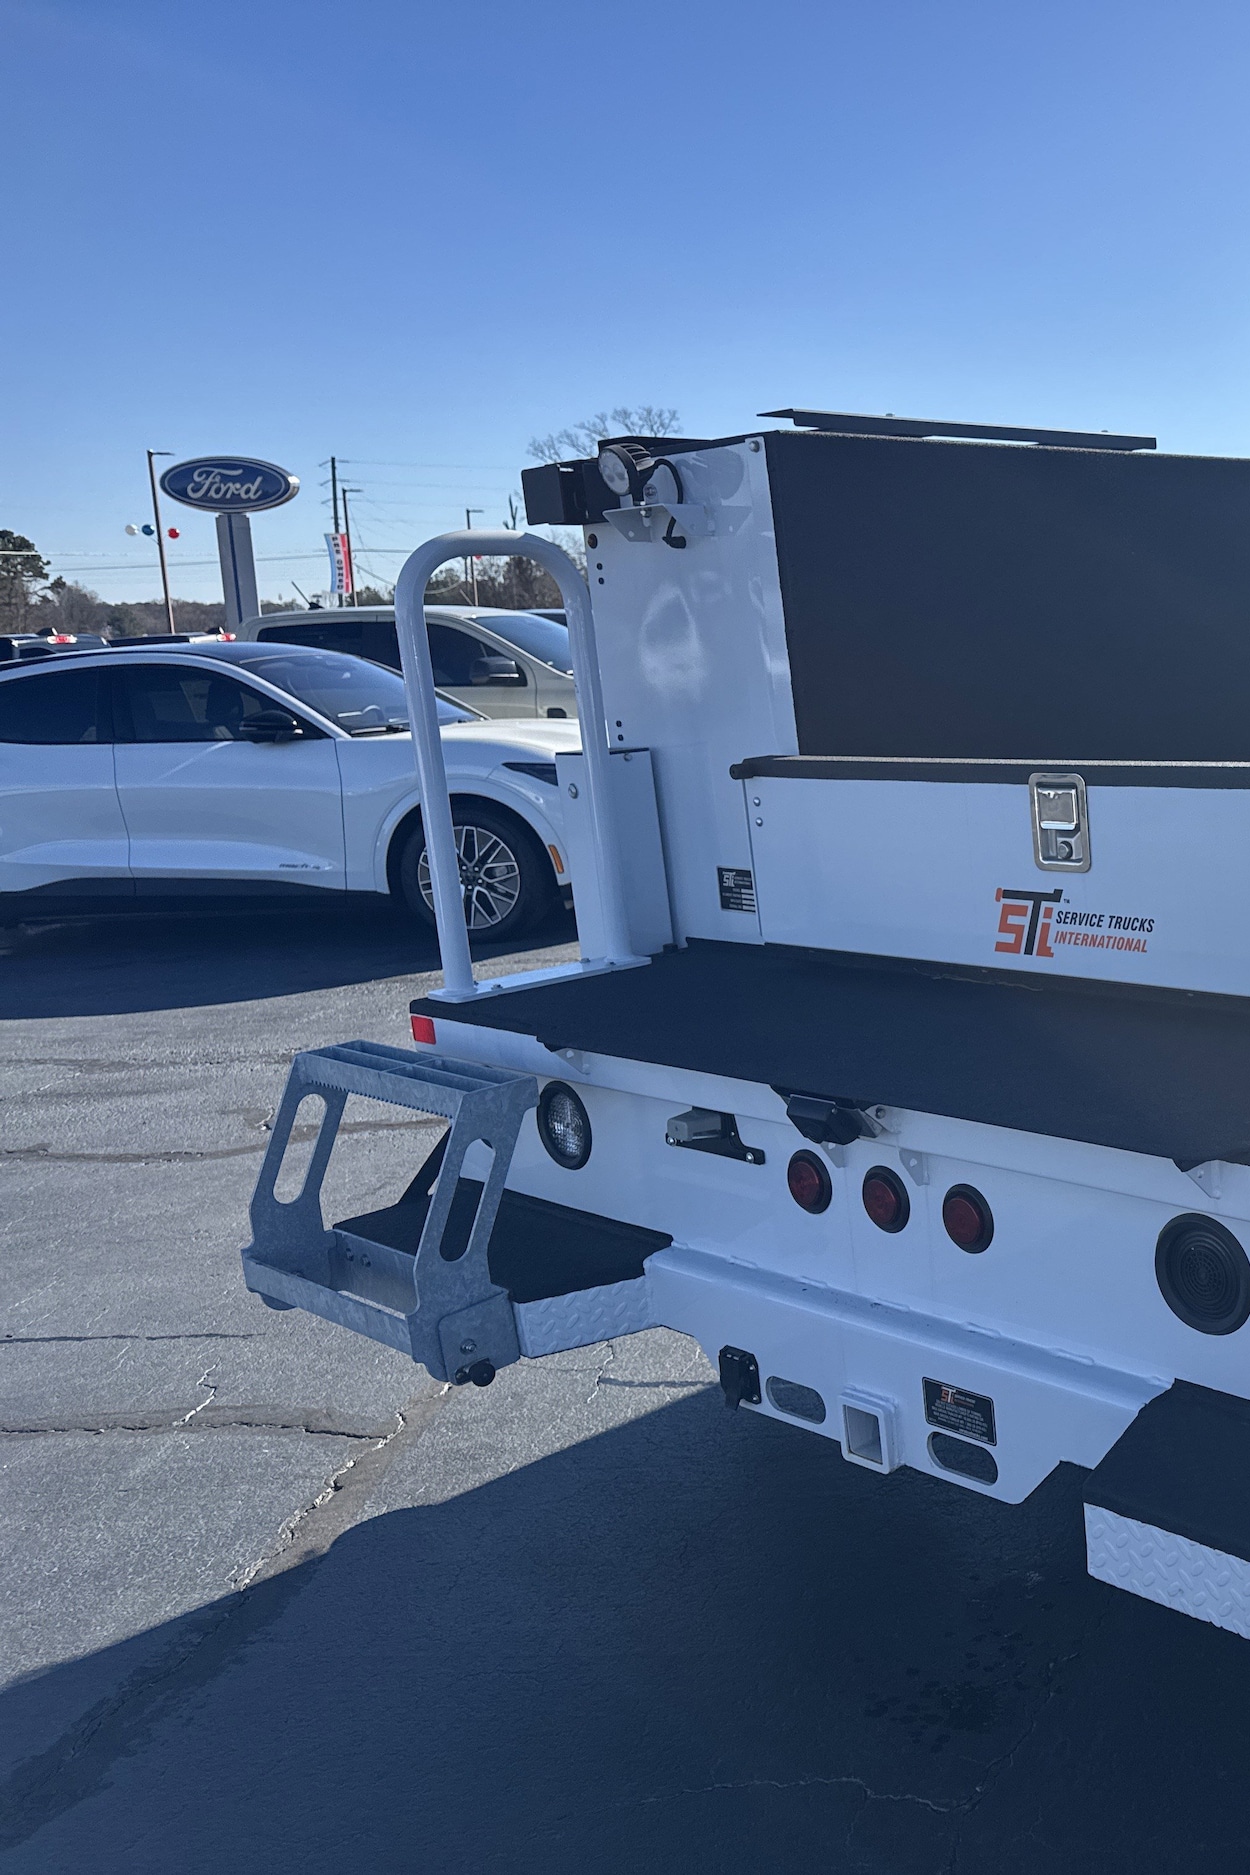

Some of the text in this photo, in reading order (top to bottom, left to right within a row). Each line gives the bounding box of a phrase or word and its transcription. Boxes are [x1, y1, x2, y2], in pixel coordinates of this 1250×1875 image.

[186, 467, 263, 500] Ford
[1055, 910, 1155, 933] SERVICE TRUCKS
[1054, 931, 1148, 953] INTERNATIONAL
